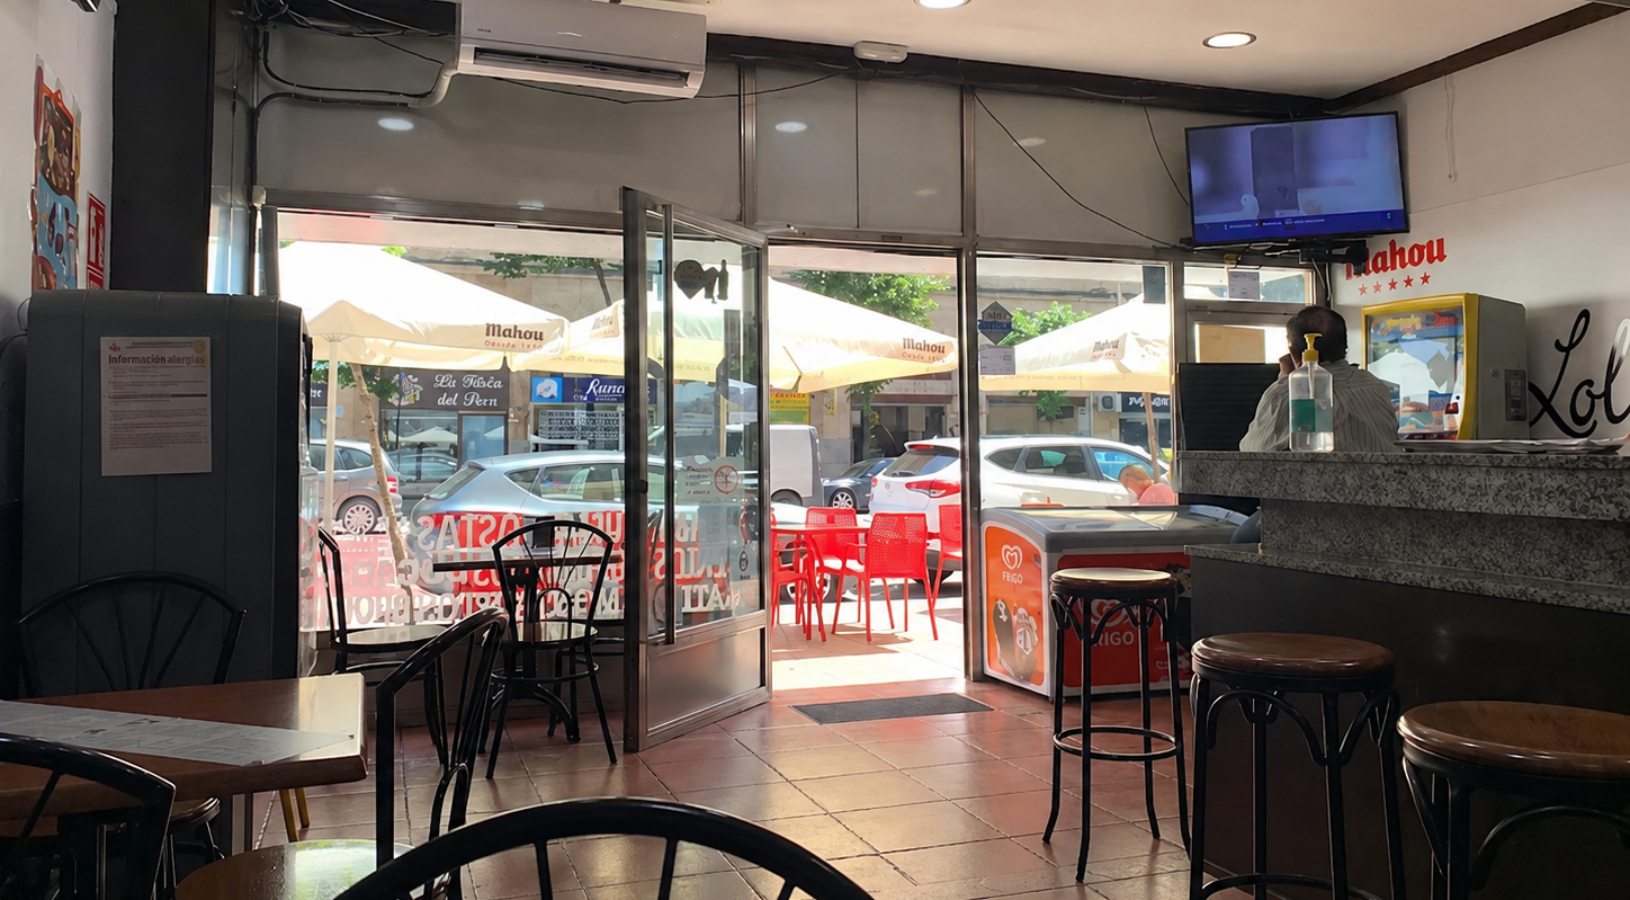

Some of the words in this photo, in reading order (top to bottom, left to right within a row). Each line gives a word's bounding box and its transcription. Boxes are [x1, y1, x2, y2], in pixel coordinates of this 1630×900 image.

[484, 322, 544, 341] Mahou
[902, 337, 946, 354] Mahou
[437, 393, 458, 406] del
[1093, 631, 1135, 647] RIGO
